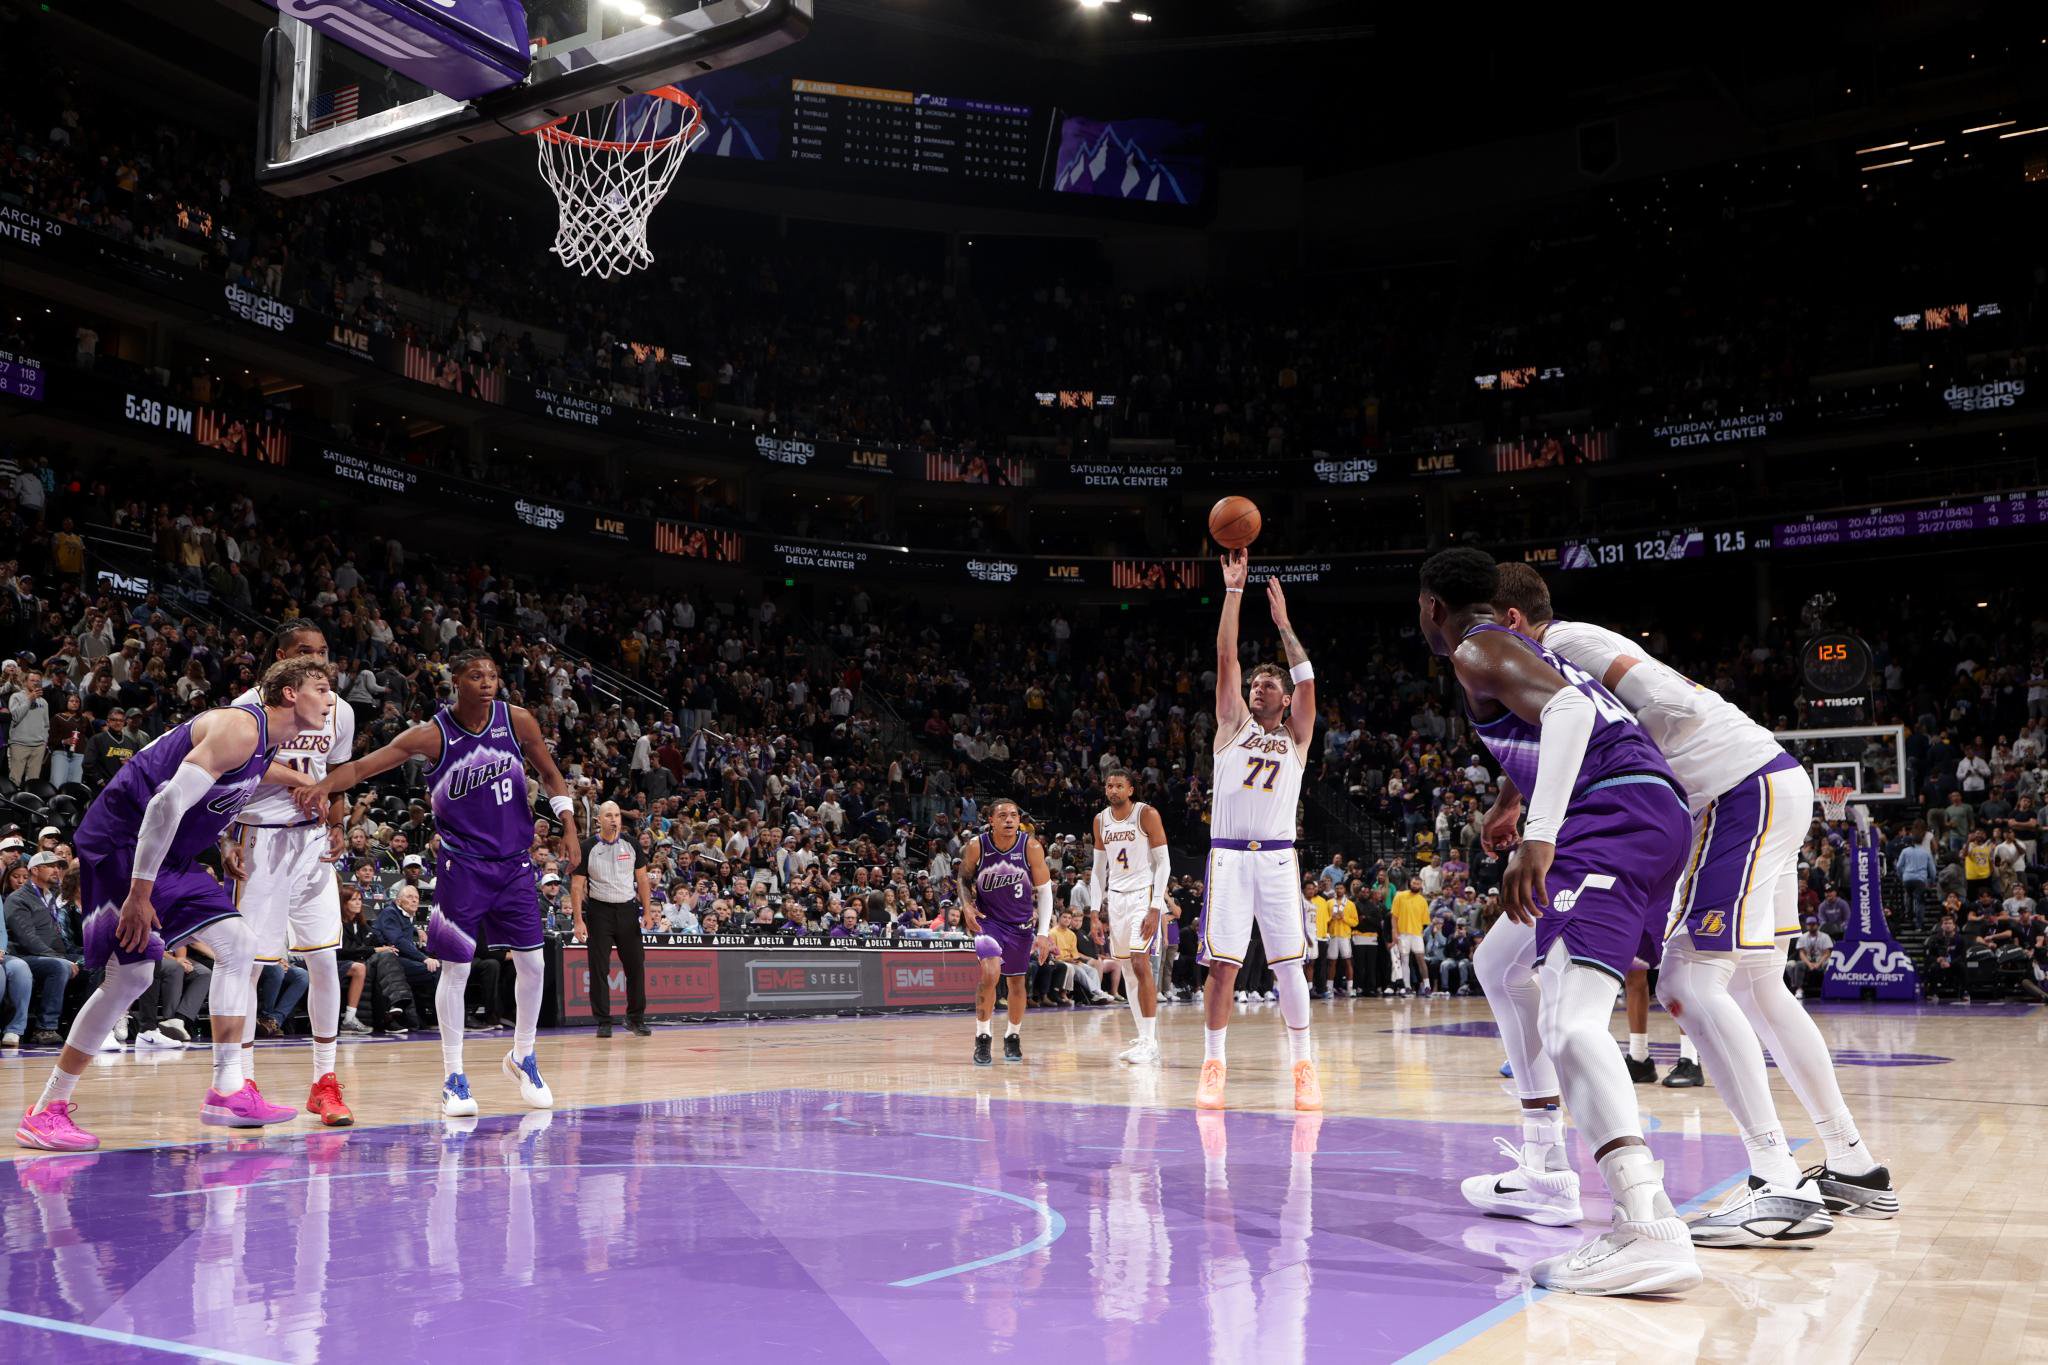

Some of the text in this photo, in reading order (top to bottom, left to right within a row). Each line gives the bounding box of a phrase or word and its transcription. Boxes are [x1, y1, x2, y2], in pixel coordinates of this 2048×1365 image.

[929, 97, 948, 106] JAZZ
[45, 220, 62, 237] 20
[224, 283, 295, 324] dancing
[240, 304, 285, 332] stars
[332, 324, 369, 351] LIVE
[20, 368, 36, 381] 118
[19, 383, 36, 396] 127
[1943, 379, 2025, 400] dancing
[563, 395, 598, 412] MARCH
[600, 404, 612, 416] 20
[1962, 393, 2015, 411] stars
[125, 394, 193, 434] 5:36 PM
[556, 407, 599, 426] CENTER
[1653, 411, 1783, 438] SATURDAY, MARCH 20
[1670, 425, 1767, 447] DELTA CENTER
[755, 433, 816, 458] dancing
[768, 448, 807, 465] stars
[852, 449, 888, 468] LIVE
[1313, 456, 1378, 473] dancing
[1416, 453, 1455, 471] LIVE
[322, 450, 417, 484] SATURDAY, MARCH 20
[1070, 464, 1183, 475] SATURDAY, MARCH 20
[335, 464, 405, 493] DELTA CENTER
[1085, 476, 1168, 486] DELTA CENTER
[1329, 470, 1370, 483] stars
[514, 498, 565, 523] dancing
[1989, 504, 1996, 513] 4
[2011, 501, 2025, 511] 25
[525, 513, 558, 530] stars
[595, 517, 625, 535] LIVE
[2012, 513, 2026, 523] 32
[774, 544, 867, 561] SATURDAY, MARCH 20
[1523, 548, 1558, 562] LIVE
[1597, 531, 1771, 564] 131 123 12.5 4TH
[785, 555, 855, 570] DELTA CENTER
[966, 558, 1019, 575] dancing
[1049, 565, 1080, 577] LIVE
[1247, 563, 1331, 574] TURDAY, MARCH 20
[978, 570, 1012, 582] stars
[1280, 573, 1319, 582] CENTER
[1819, 644, 1847, 660] 12.5
[1824, 697, 1865, 707] TISSOT
[280, 735, 331, 754] KERS
[1239, 732, 1288, 755] LAKERS
[448, 756, 513, 801] UTAH
[1243, 757, 1281, 792] 77
[490, 777, 514, 806] 19
[1103, 829, 1136, 845] LAKERS
[1116, 847, 1130, 870] 4
[1013, 884, 1024, 899] 3
[1858, 850, 1872, 935] AMERICA FIRST
[642, 935, 658, 944] LTA
[676, 935, 703, 945] DELTA
[720, 936, 745, 945] DELTA
[761, 936, 785, 945] DELTA
[799, 937, 822, 946] DELTA
[836, 938, 858, 947] DELTA
[871, 939, 891, 947] DELTA
[903, 939, 923, 948] DELTA
[934, 940, 953, 948] DELTA
[964, 941, 976, 949] DEL
[650, 974, 703, 986] STEEL
[757, 969, 854, 989] SME STEEL
[895, 969, 935, 987] SME
[1875, 973, 1904, 982] FIRST
